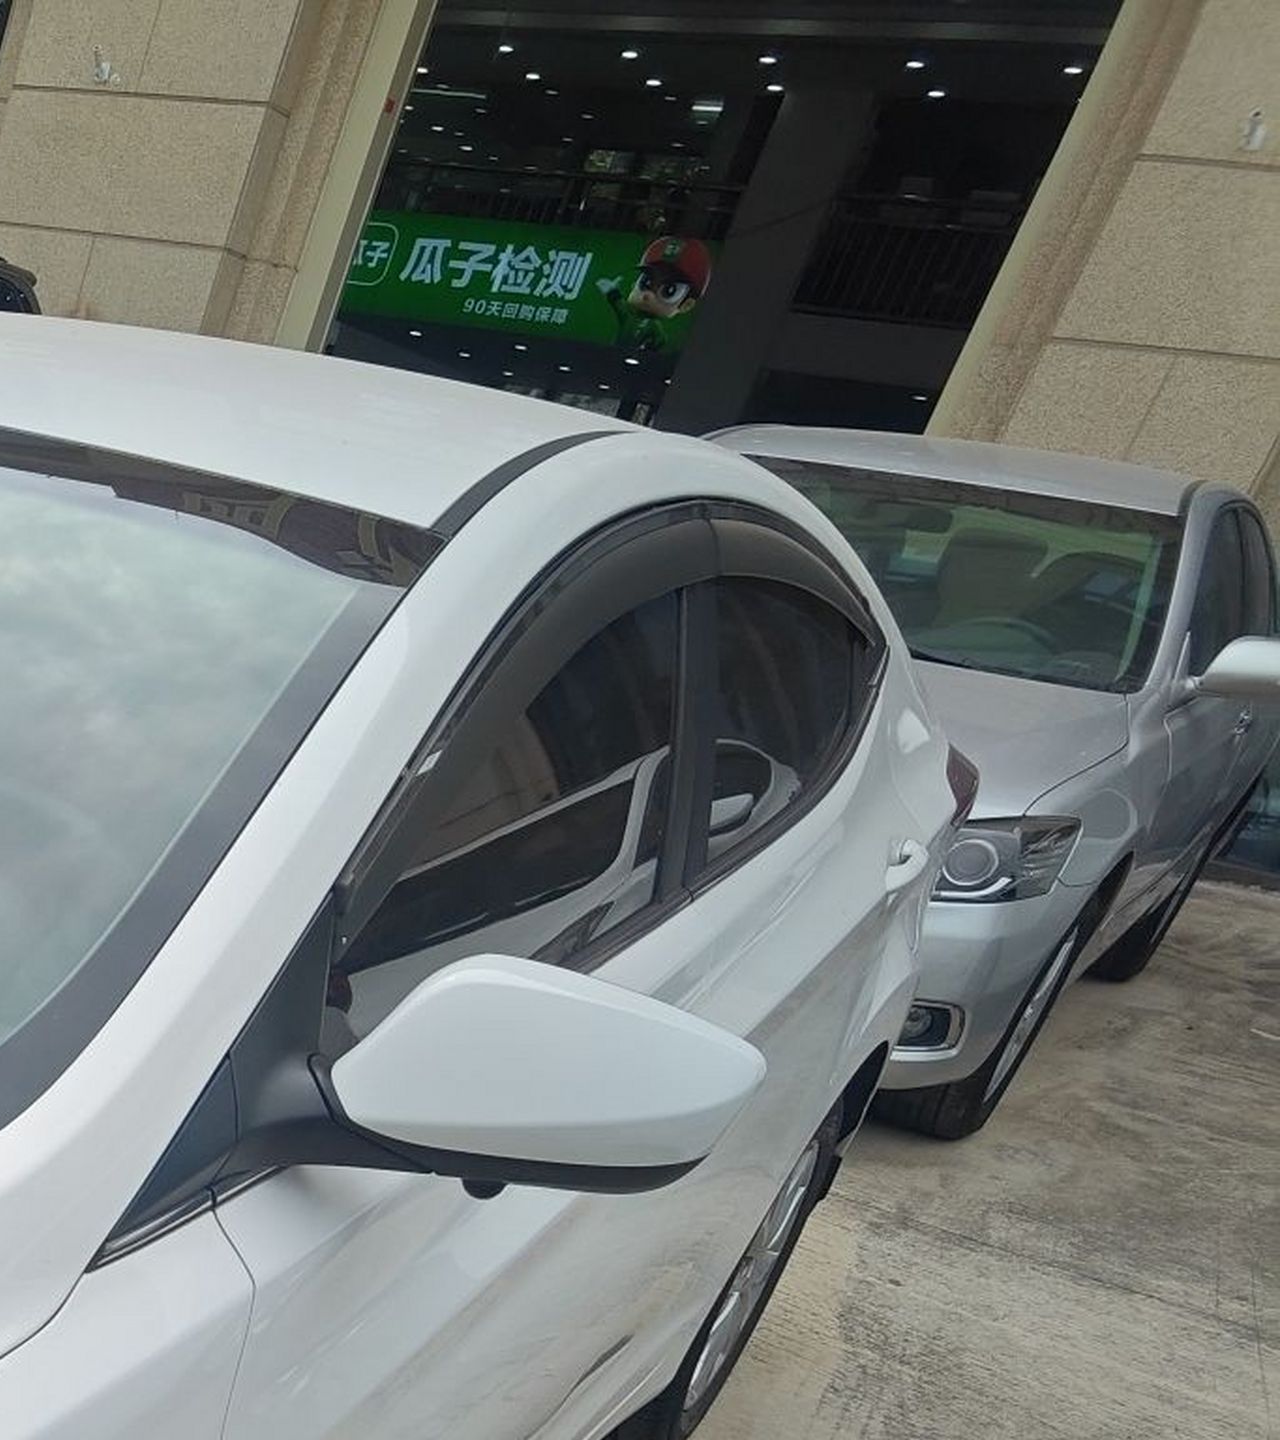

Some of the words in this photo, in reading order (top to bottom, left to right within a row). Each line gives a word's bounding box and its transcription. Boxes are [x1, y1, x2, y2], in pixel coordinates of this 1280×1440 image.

[399, 238, 593, 300] 瓜子检测
[463, 298, 569, 324] 90天回购保障
